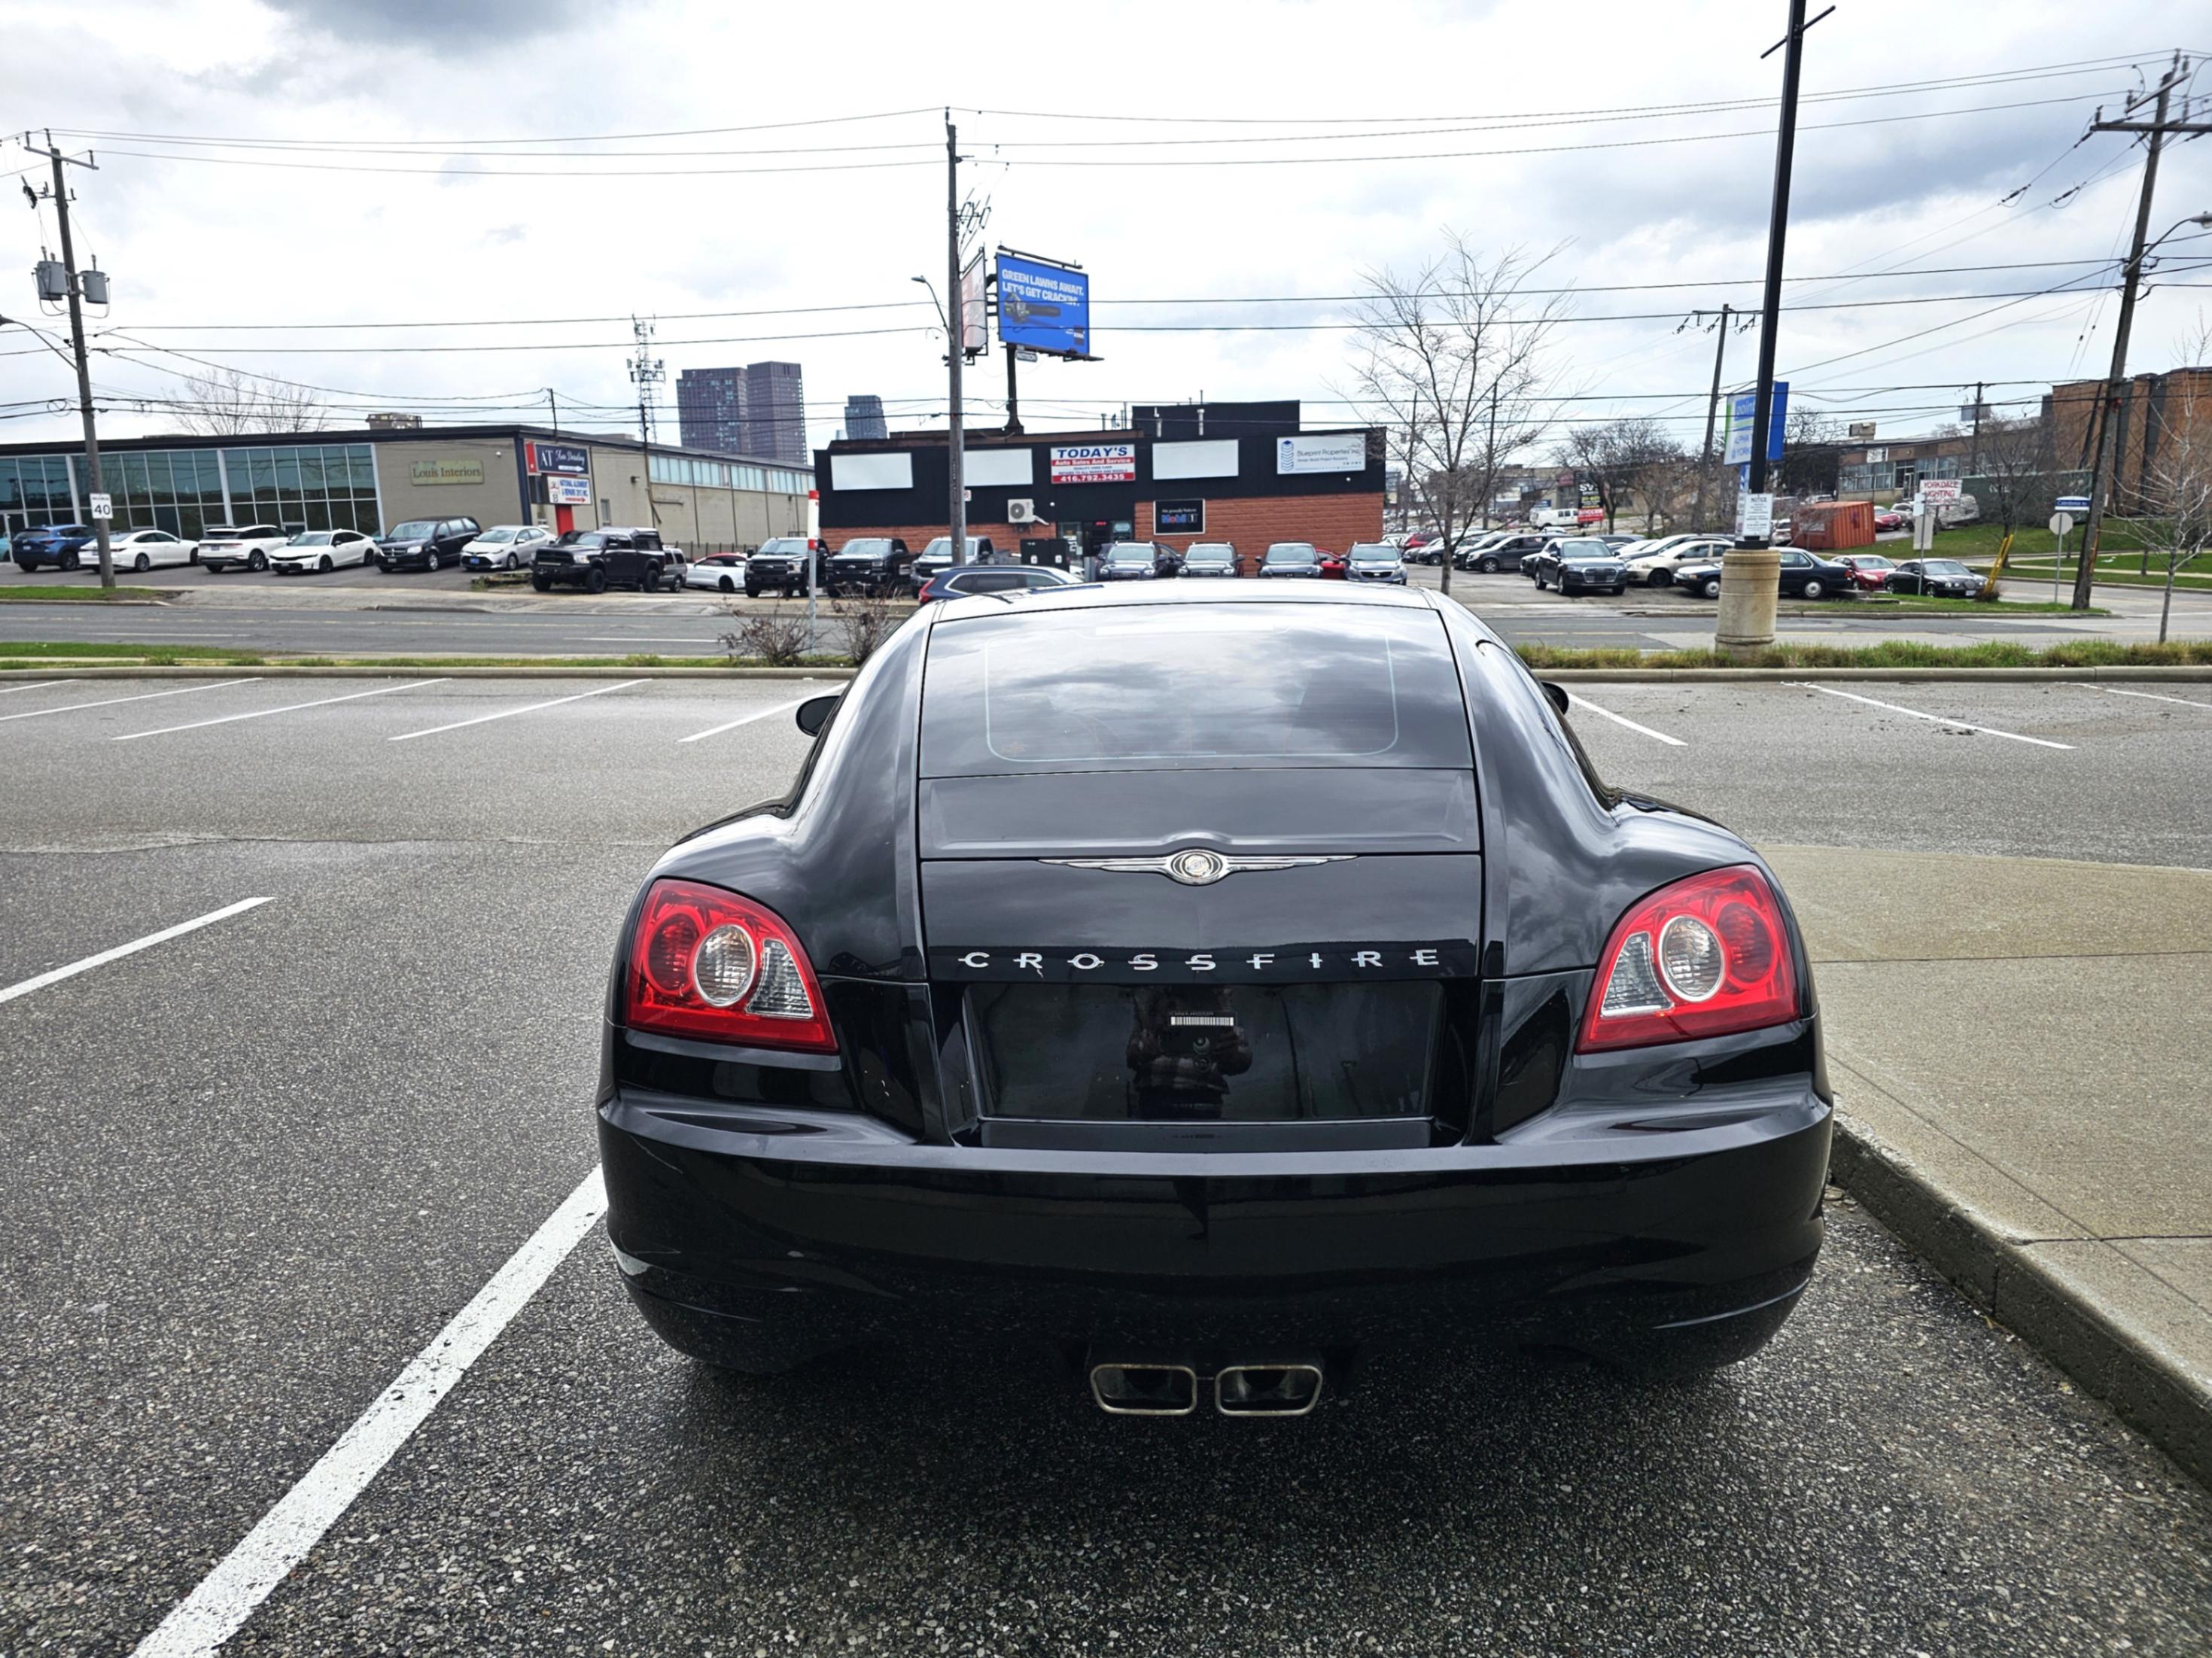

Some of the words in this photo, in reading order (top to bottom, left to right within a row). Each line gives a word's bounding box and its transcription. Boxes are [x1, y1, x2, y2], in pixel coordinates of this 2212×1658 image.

[1002, 269, 1030, 284] GREEN
[1030, 275, 1058, 291] LAWNS
[1059, 281, 1085, 297] AWAIT.
[1002, 281, 1024, 295] LET'S
[1025, 286, 1042, 299] GET
[541, 449, 553, 467] AT
[1057, 446, 1128, 458] TODAY'S
[1297, 449, 1321, 458] Blueprint
[1322, 448, 1349, 456] Properties
[412, 467, 439, 478] Louis
[441, 467, 482, 477] Interiors
[94, 504, 111, 515] 40
[958, 949, 1440, 971] CROSSFIRE
